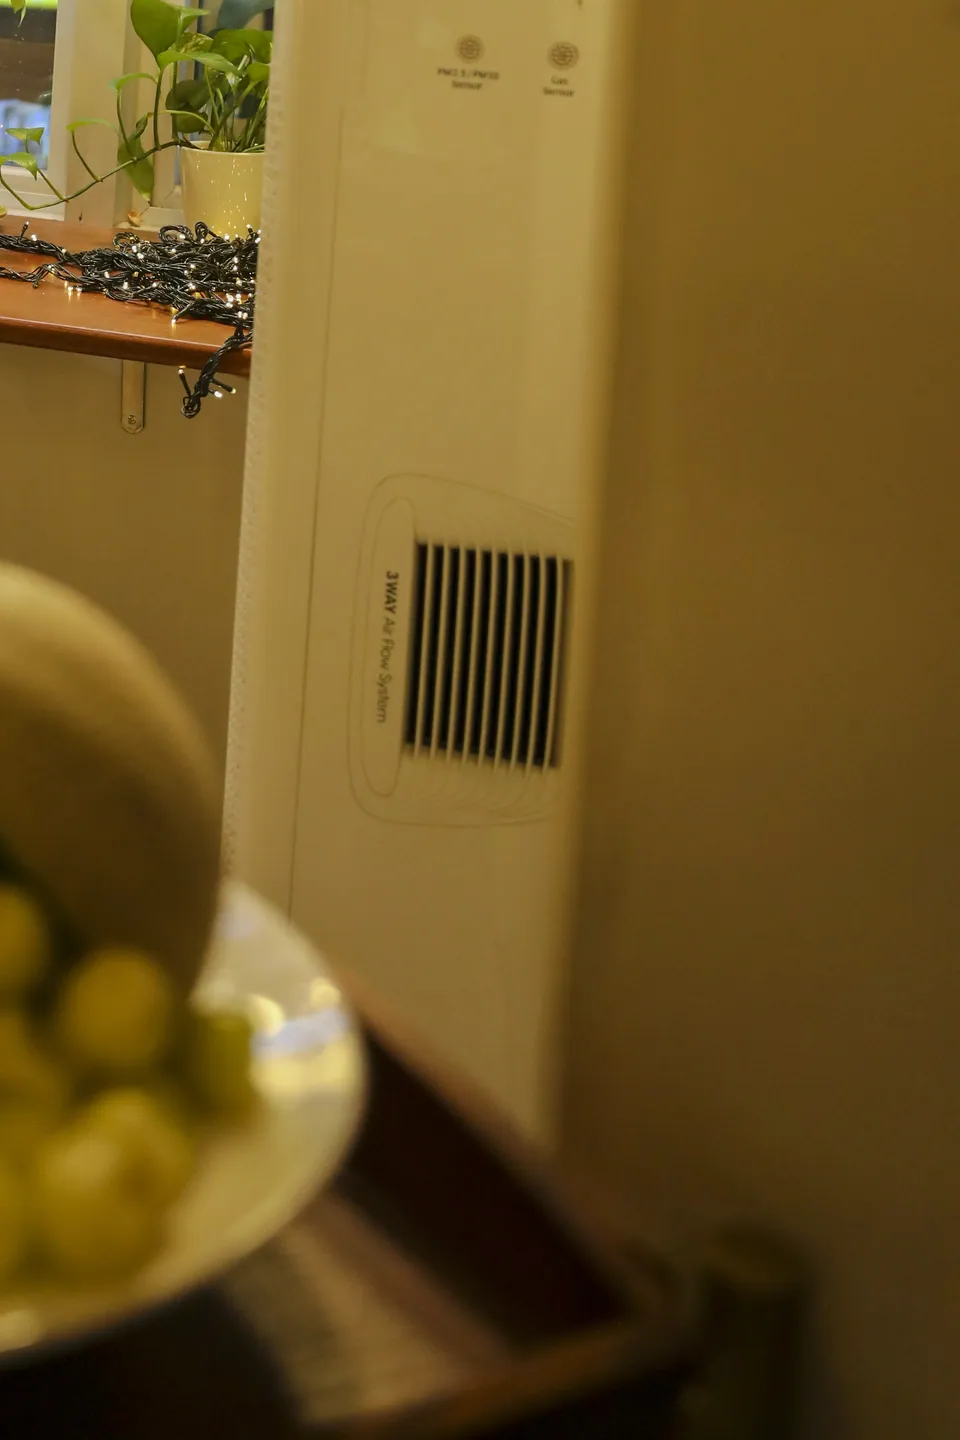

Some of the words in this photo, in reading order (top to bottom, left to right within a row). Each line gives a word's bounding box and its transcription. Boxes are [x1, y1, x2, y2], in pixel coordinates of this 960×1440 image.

[384, 570, 400, 615] 3WAY
[382, 616, 396, 636] Air
[380, 638, 395, 671] Flow
[375, 672, 393, 725] System
